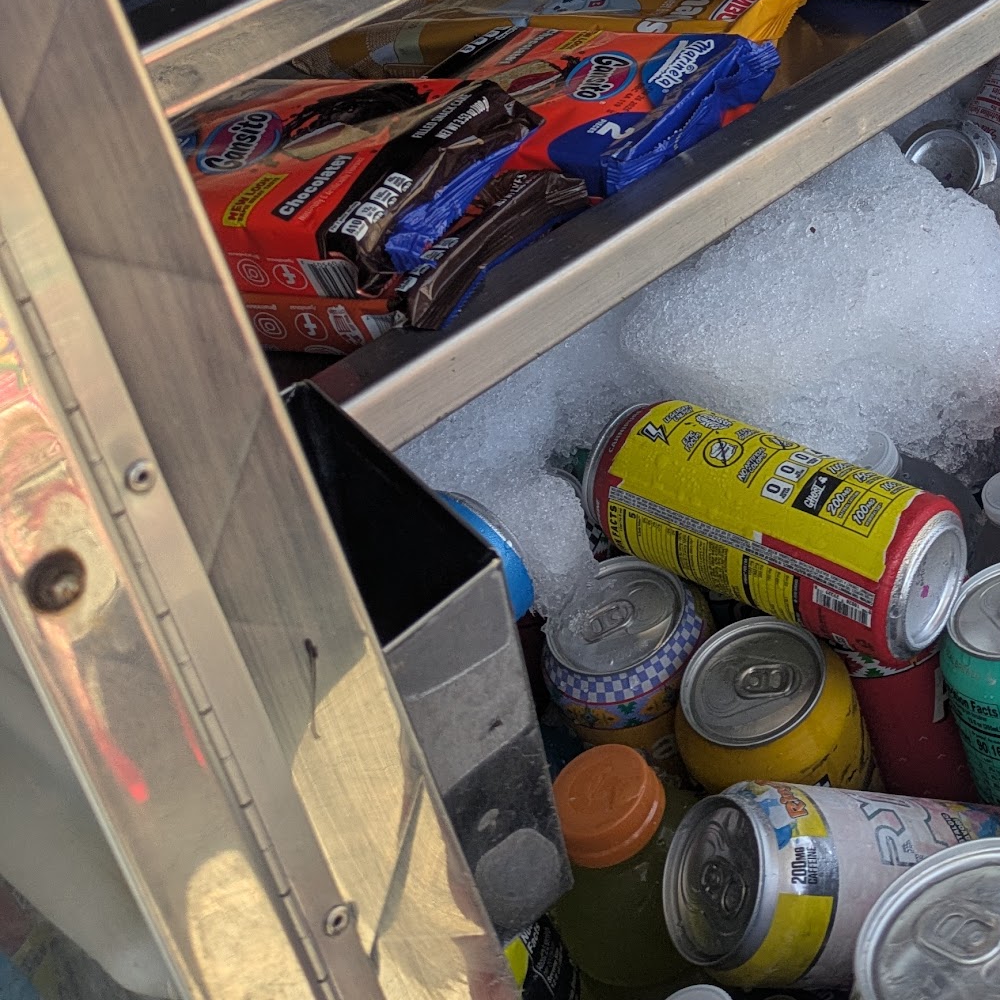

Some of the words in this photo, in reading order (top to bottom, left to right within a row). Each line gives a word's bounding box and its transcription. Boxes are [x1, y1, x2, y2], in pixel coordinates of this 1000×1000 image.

[573, 51, 632, 101] Gansito
[204, 110, 274, 171] Gansito
[599, 120, 635, 140] 2
[278, 154, 354, 216] Chocolatey
[227, 195, 247, 221] NEW
[347, 220, 362, 235] 410
[737, 469, 747, 482] NO
[803, 480, 827, 509] GHOST
[969, 700, 999, 719] Facts
[807, 844, 818, 885] CAFFEINE
